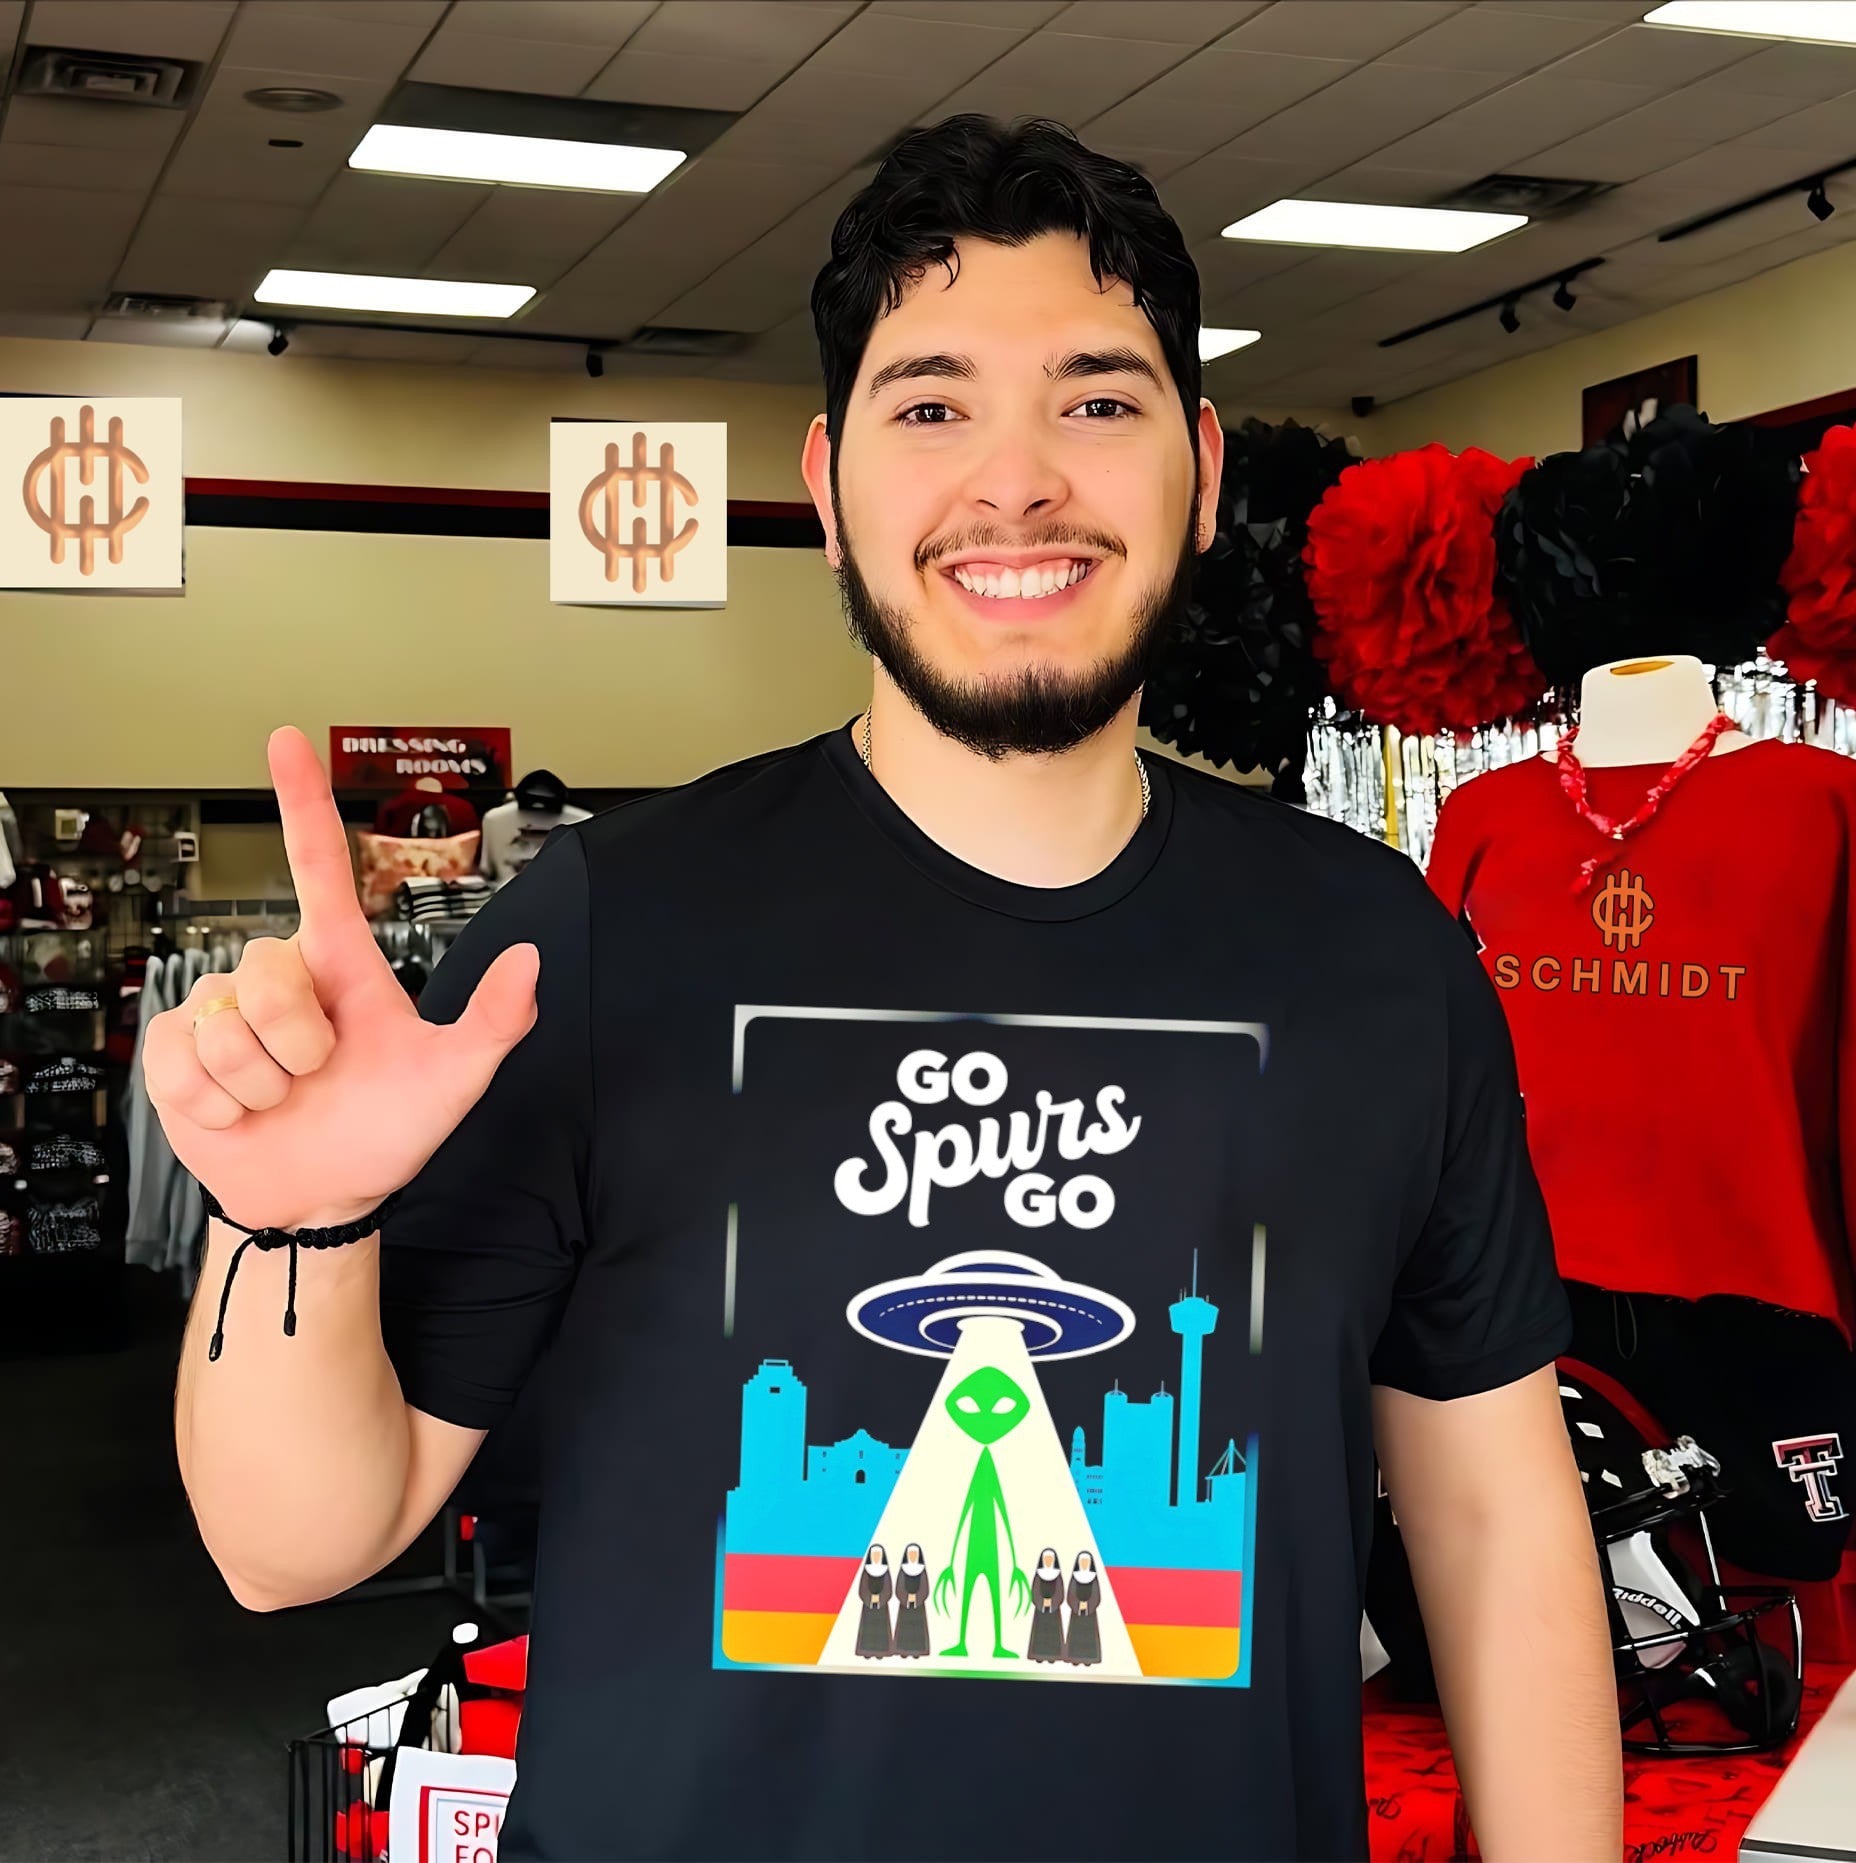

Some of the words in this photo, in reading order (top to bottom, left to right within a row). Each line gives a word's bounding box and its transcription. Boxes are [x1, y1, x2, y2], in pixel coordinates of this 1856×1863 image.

[342, 737, 467, 754] DRESSING
[396, 758, 487, 774] ROOMS
[1494, 954, 1746, 1000] SCHMIDT
[896, 1049, 1008, 1106] GO
[834, 1084, 1142, 1228] Spurs
[1004, 1172, 1116, 1230] GO
